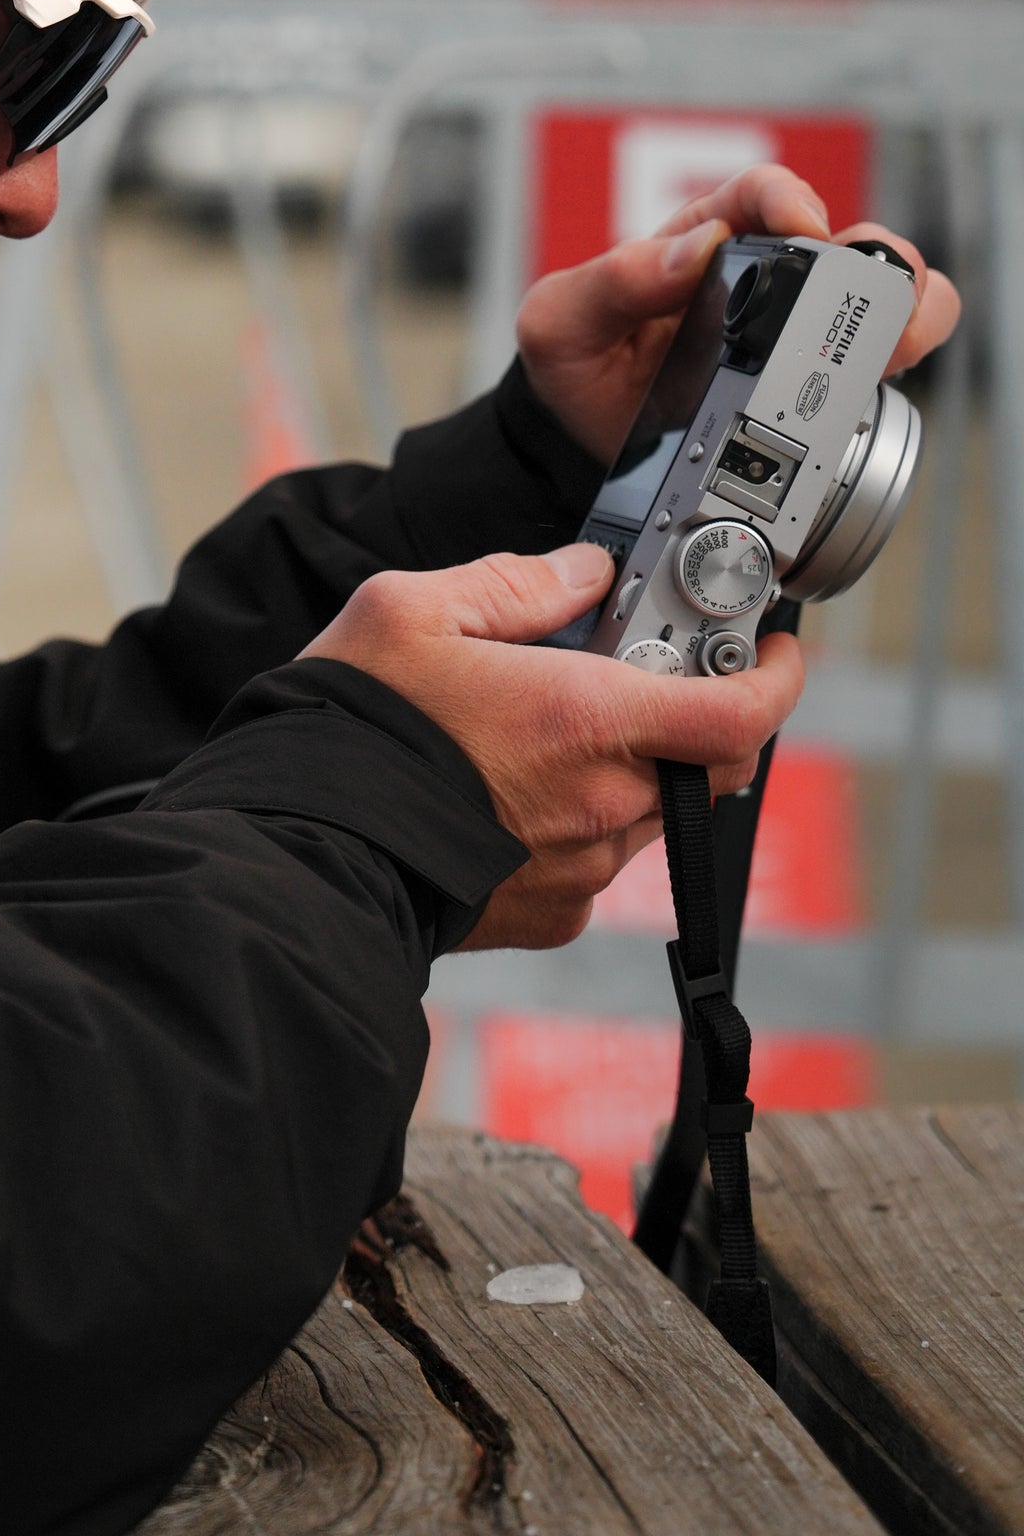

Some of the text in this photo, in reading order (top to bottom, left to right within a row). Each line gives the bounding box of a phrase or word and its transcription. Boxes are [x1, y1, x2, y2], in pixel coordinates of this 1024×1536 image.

[831, 297, 870, 365] FUJIFILM
[807, 374, 819, 390] LENS
[810, 384, 827, 413] FUJINON
[702, 535, 714, 552] 1000
[710, 531, 721, 550] 2000
[721, 529, 729, 549] 4000
[690, 549, 704, 561] 250
[694, 542, 708, 555] 500
[688, 560, 701, 570] 125
[687, 570, 698, 578] 60
[689, 578, 700, 589] 30
[694, 586, 704, 596] 15
[747, 593, 756, 602] B
[701, 596, 709, 604] 8
[697, 618, 710, 634] ON
[685, 636, 698, 655] OFF
